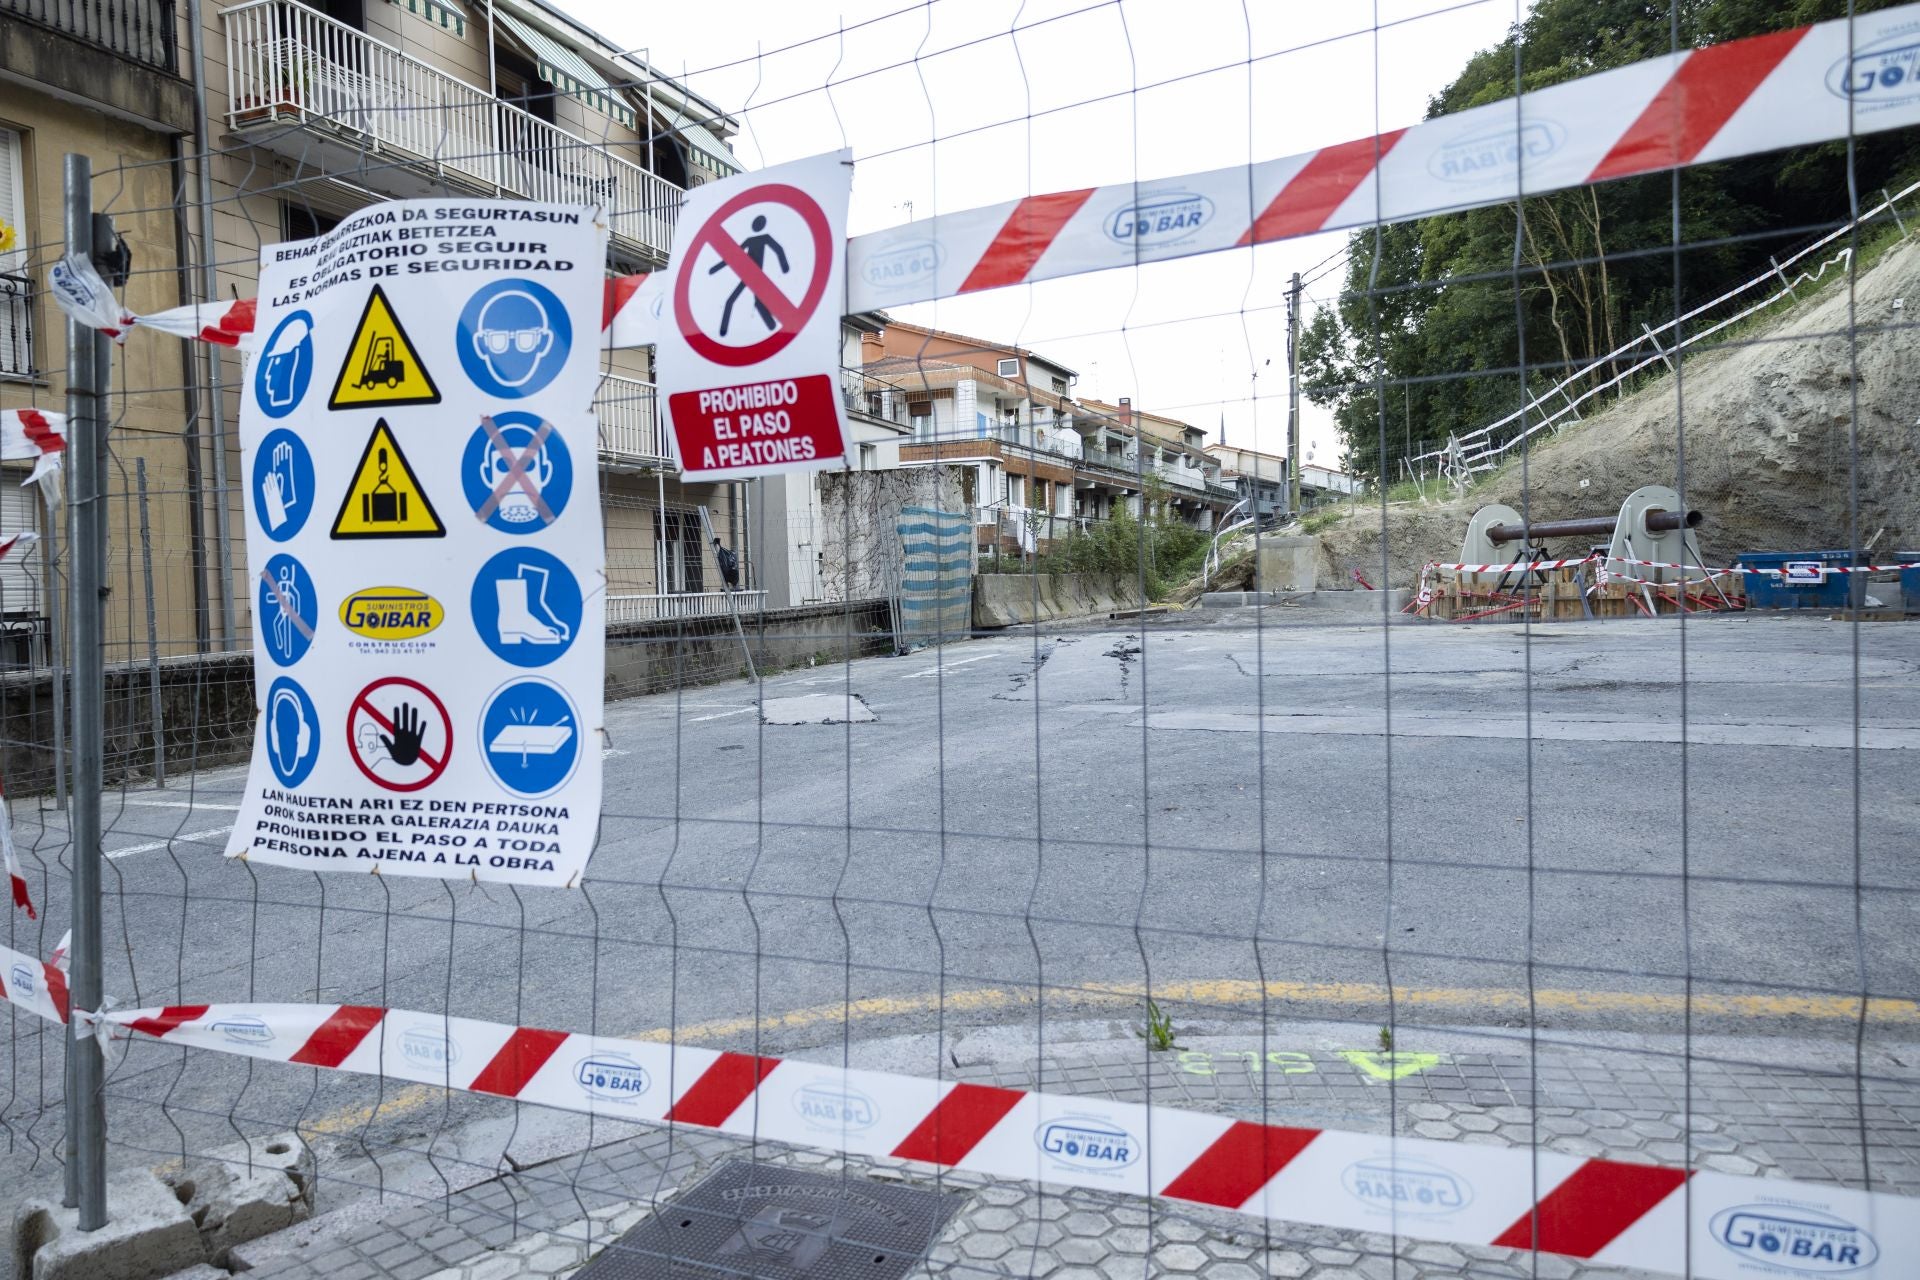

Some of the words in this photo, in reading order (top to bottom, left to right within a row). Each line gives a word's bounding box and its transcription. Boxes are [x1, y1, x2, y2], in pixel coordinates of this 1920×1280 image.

[276, 244, 318, 262] BEHAR
[402, 209, 428, 222] DA
[434, 208, 579, 225] SEGURTASUN
[339, 230, 393, 254] GUZTIAK
[399, 225, 497, 240] BETETZEA
[289, 276, 307, 290] ES
[312, 243, 428, 282] OBLIGATORIO
[438, 241, 547, 254] SEGUIR
[272, 292, 301, 308] LAS
[304, 269, 362, 301] NORMAS
[369, 263, 400, 278] DE
[407, 258, 574, 275] SEGURIDAD
[699, 380, 798, 415] PROHIBIDO
[713, 417, 738, 440] EL
[739, 410, 791, 438] PASO
[703, 446, 716, 469] A
[718, 435, 816, 467] PEATONES
[345, 595, 432, 629] GOIBAR
[366, 603, 429, 611] SUMINISTROS
[262, 788, 284, 801] LAN
[286, 793, 353, 809] HAUETAN
[360, 798, 394, 810] ARI
[400, 799, 424, 811] EZ
[429, 800, 467, 813] DEN
[472, 802, 570, 819] PERTSONA
[264, 804, 295, 821] OROK
[297, 811, 385, 826] SARRERA
[391, 814, 490, 831] GALERAZIA
[496, 820, 559, 836] DAUKA
[253, 836, 348, 858] PERSONA
[356, 847, 427, 862] AJENA
[433, 852, 447, 864] A
[455, 853, 481, 866] LA
[489, 855, 555, 872] OBRA
[256, 820, 367, 842] PROHIBIDO
[376, 831, 404, 844] EL
[411, 833, 467, 847] PASO
[473, 837, 488, 848] A
[497, 838, 561, 854] TODA
[1758, 1222, 1858, 1243] SUMINISTROS
